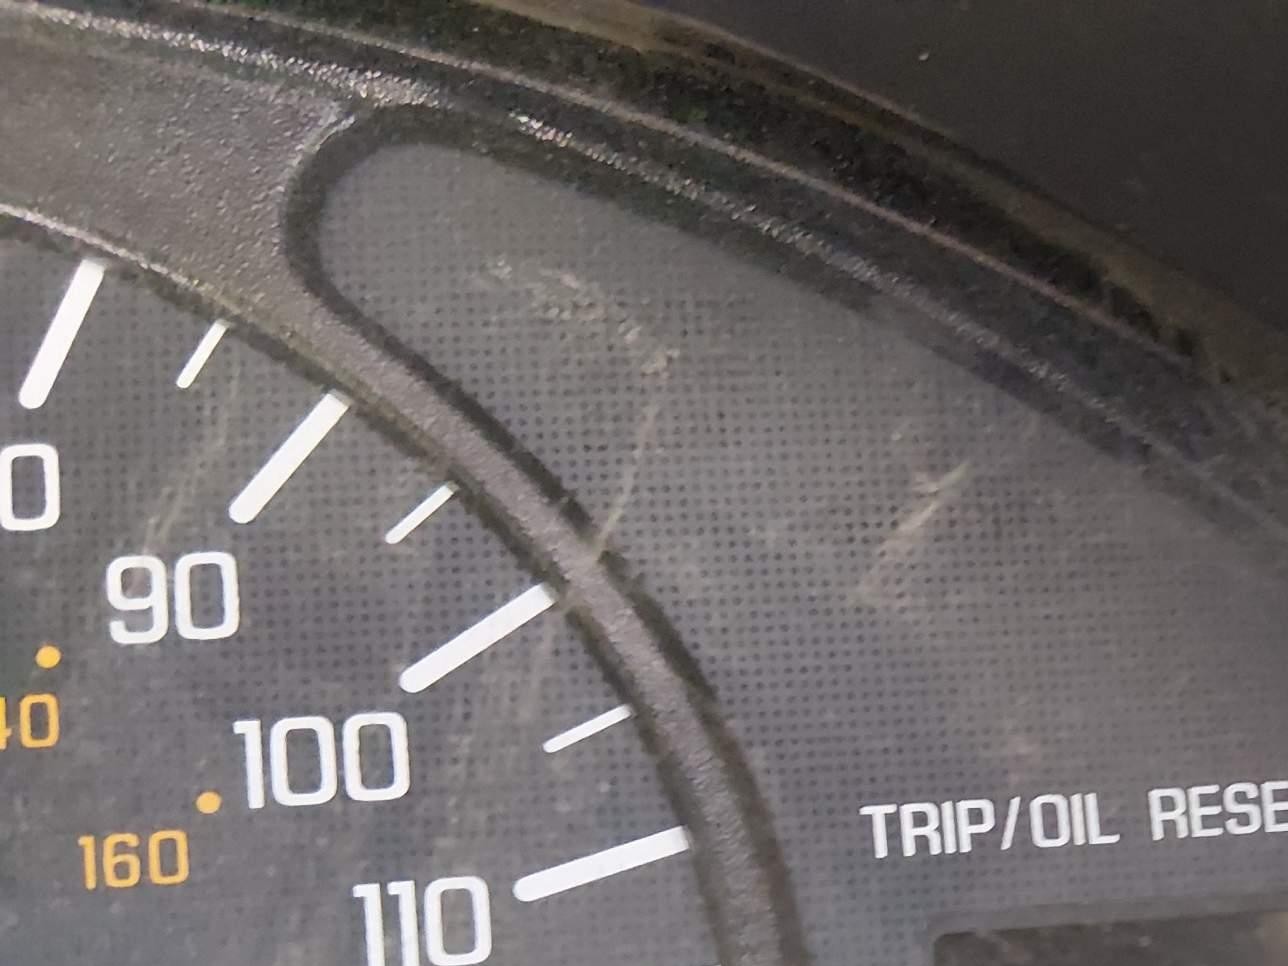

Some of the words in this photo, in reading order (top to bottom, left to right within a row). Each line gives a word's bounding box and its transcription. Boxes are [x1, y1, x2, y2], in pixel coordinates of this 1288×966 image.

[106, 551, 241, 645] 90
[233, 711, 411, 809] 100
[78, 830, 190, 890] 160
[859, 791, 1121, 859] TRIP/OIL
